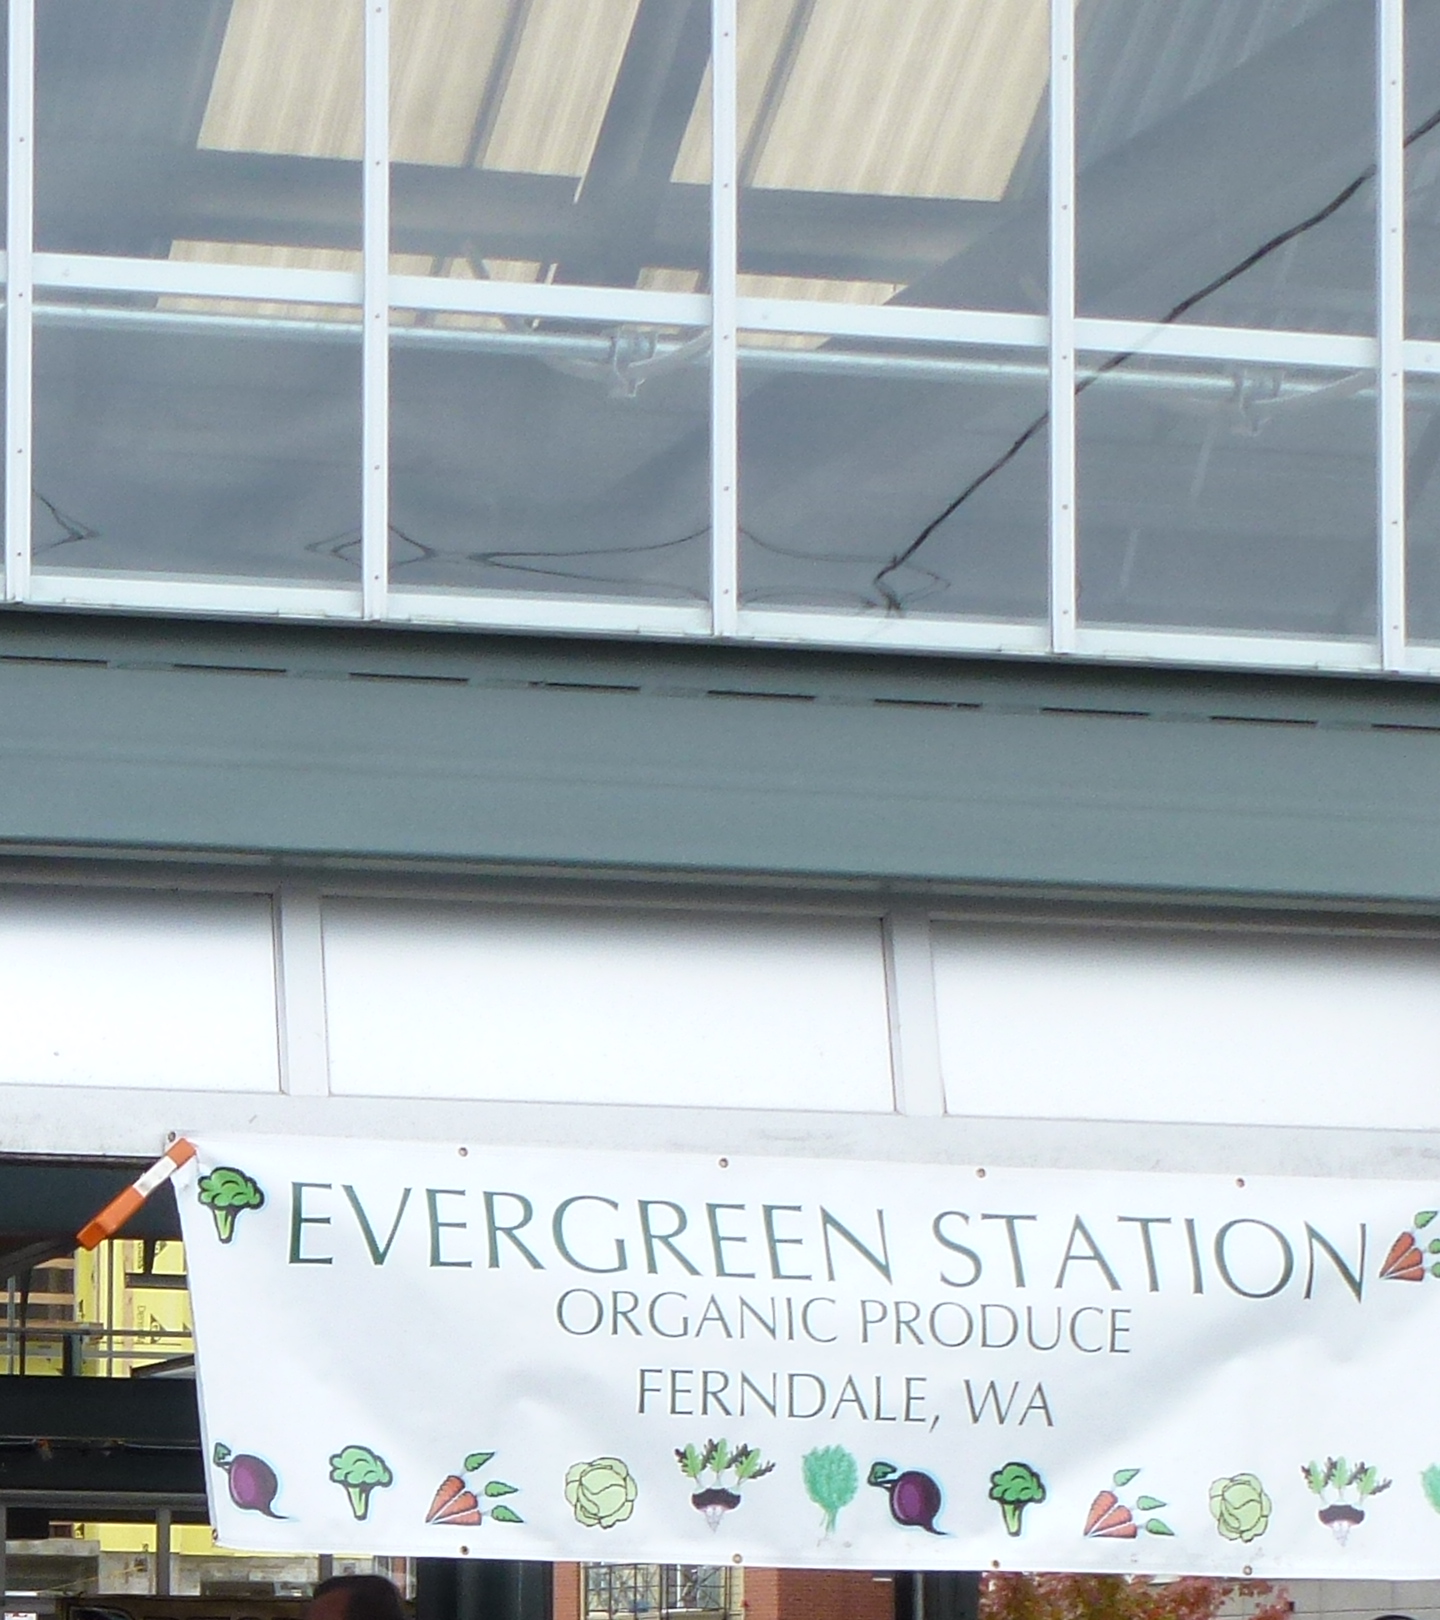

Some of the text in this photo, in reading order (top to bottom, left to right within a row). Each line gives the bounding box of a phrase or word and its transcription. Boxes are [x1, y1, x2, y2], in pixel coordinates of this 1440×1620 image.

[288, 1181, 1367, 1303] EVERGREEN STATION
[556, 1288, 1132, 1354] ORGANIC PRODUCE
[638, 1368, 1054, 1432] FERNDALE, WA
